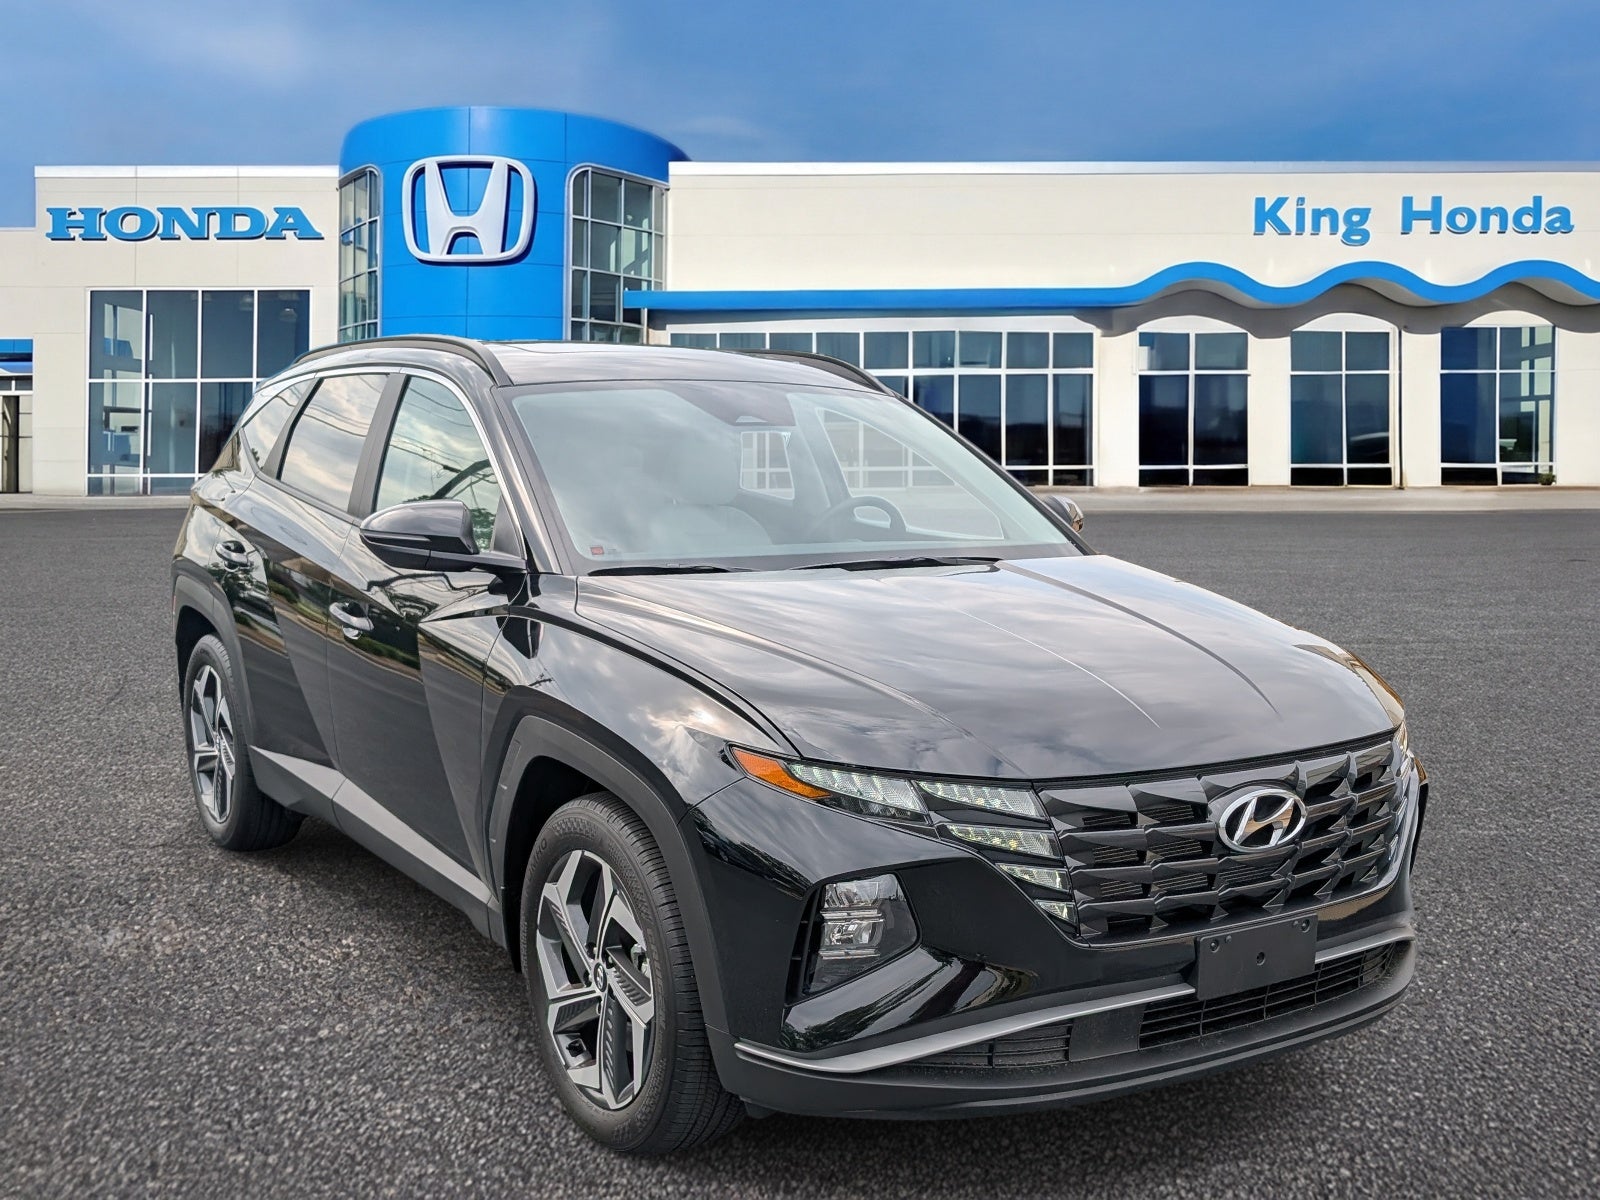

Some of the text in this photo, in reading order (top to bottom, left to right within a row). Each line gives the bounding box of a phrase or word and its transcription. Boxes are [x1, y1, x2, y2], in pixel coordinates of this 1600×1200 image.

[45, 206, 325, 241] HONDA
[1253, 195, 1575, 247] King Honda
